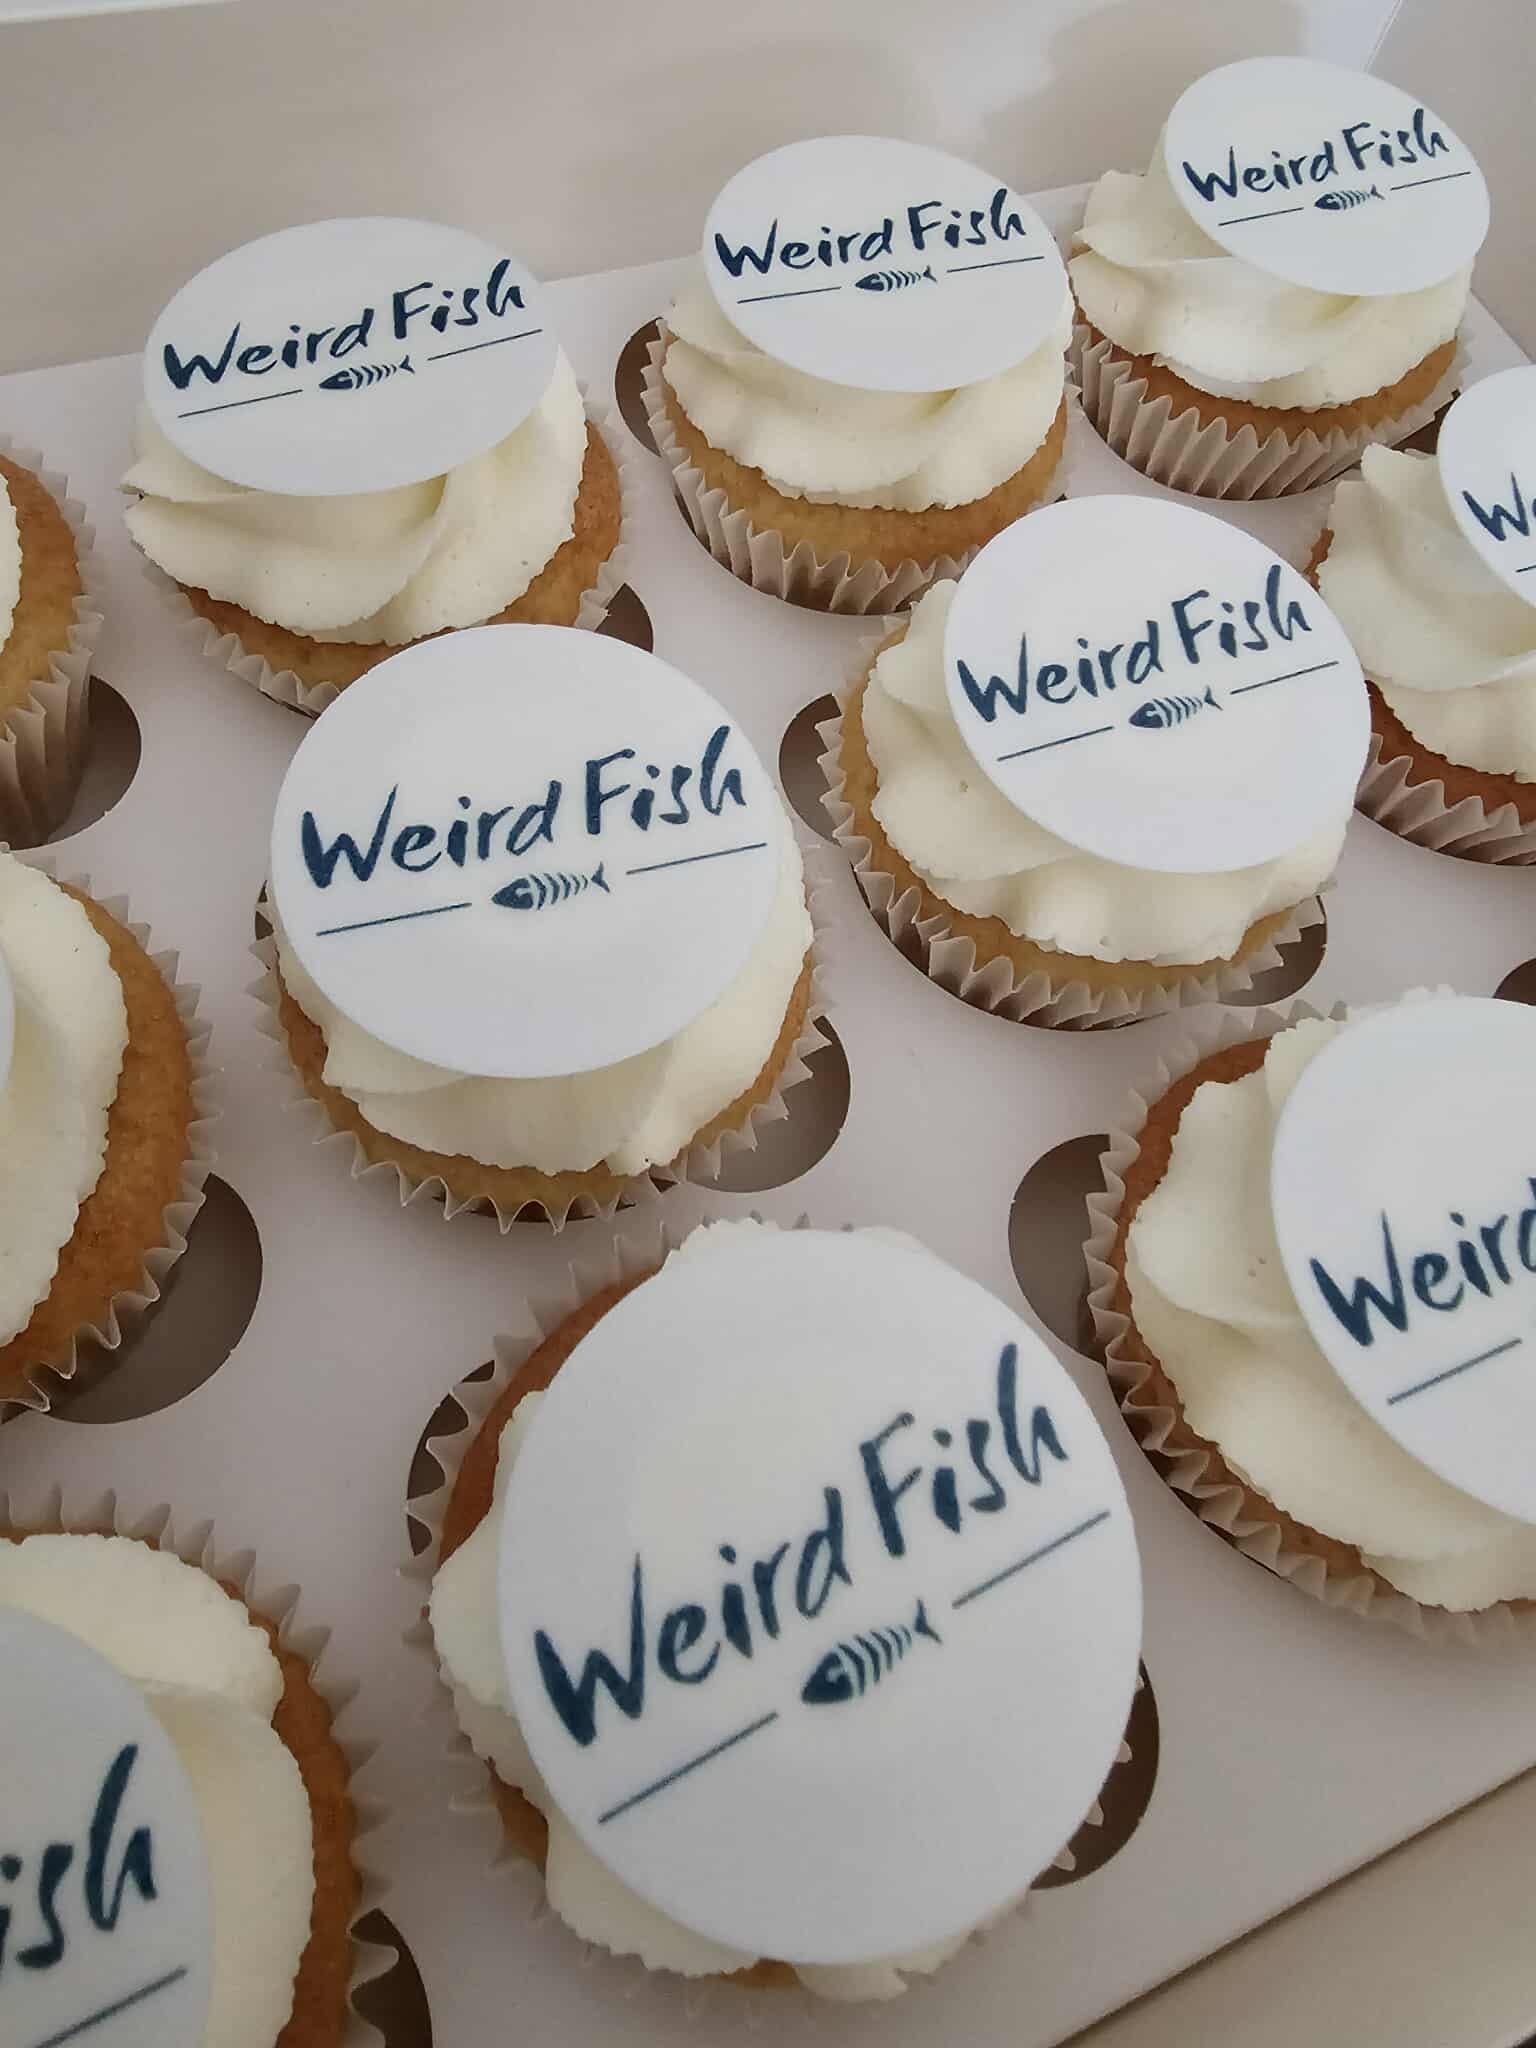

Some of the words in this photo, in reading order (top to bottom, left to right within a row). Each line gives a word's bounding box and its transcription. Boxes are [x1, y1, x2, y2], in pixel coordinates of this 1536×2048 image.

[1182, 140, 1338, 203] Weird
[1342, 107, 1450, 171] Fish
[714, 217, 895, 278] Weird
[906, 187, 1025, 251] Fish
[162, 307, 376, 391] Weird
[392, 258, 526, 341] Fish
[956, 622, 1165, 722] Weird
[1170, 564, 1313, 665] Fish
[300, 779, 564, 890] Weird
[584, 725, 747, 836] Fish
[532, 1486, 851, 1745] Weird
[858, 1343, 1069, 1560] Fish
